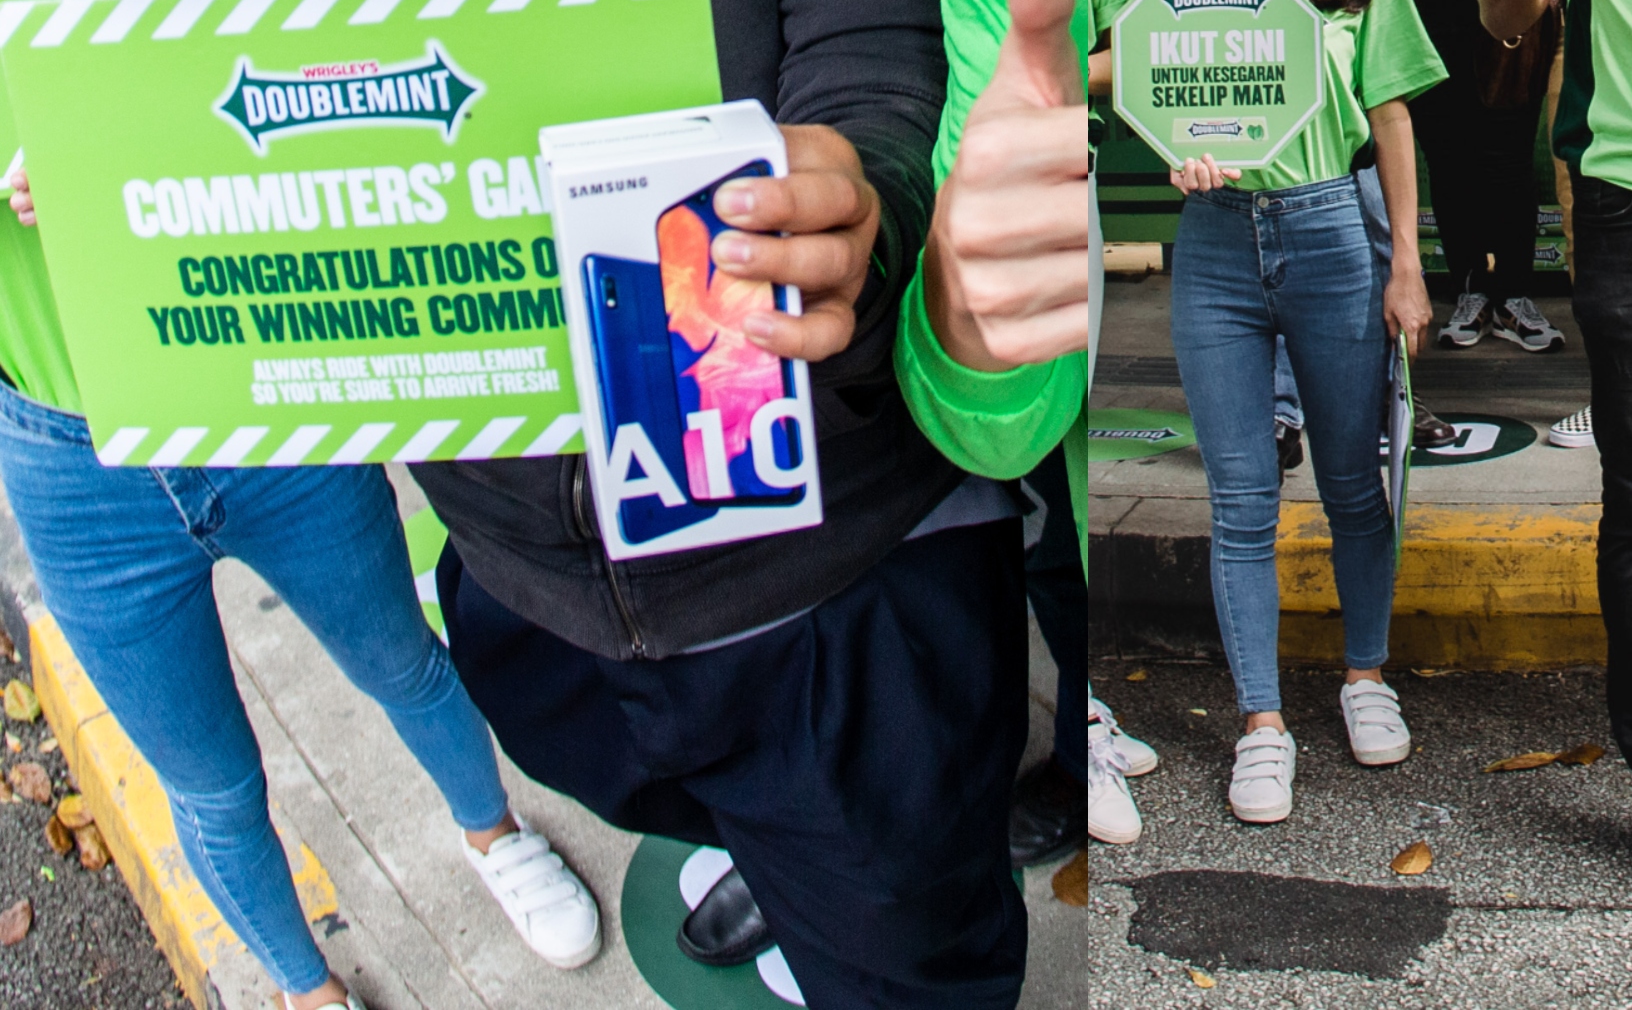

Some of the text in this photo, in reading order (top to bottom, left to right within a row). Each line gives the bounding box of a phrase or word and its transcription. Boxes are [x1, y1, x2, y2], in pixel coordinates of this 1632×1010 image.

[1150, 29, 1285, 65] IKUT SINI
[303, 62, 378, 79] WRIGLEY'S
[1152, 65, 1286, 84] UNTUK KESEGARAN
[242, 70, 450, 127] DOUBLEMINT
[1152, 84, 1286, 108] SEKELIP MATA
[123, 162, 456, 238] COMMUTERS'
[569, 176, 648, 199] SAMSUNG
[178, 236, 560, 298] CONGRATULATIONS O
[147, 303, 246, 346] YOUR
[249, 297, 421, 344] WINNING
[252, 346, 547, 382] ALWAYS RIDE WITH DOUBLEMINT
[250, 369, 560, 406] SO YOU'RE SURE TO ARRIVE FRESH!
[605, 397, 808, 509] A10
